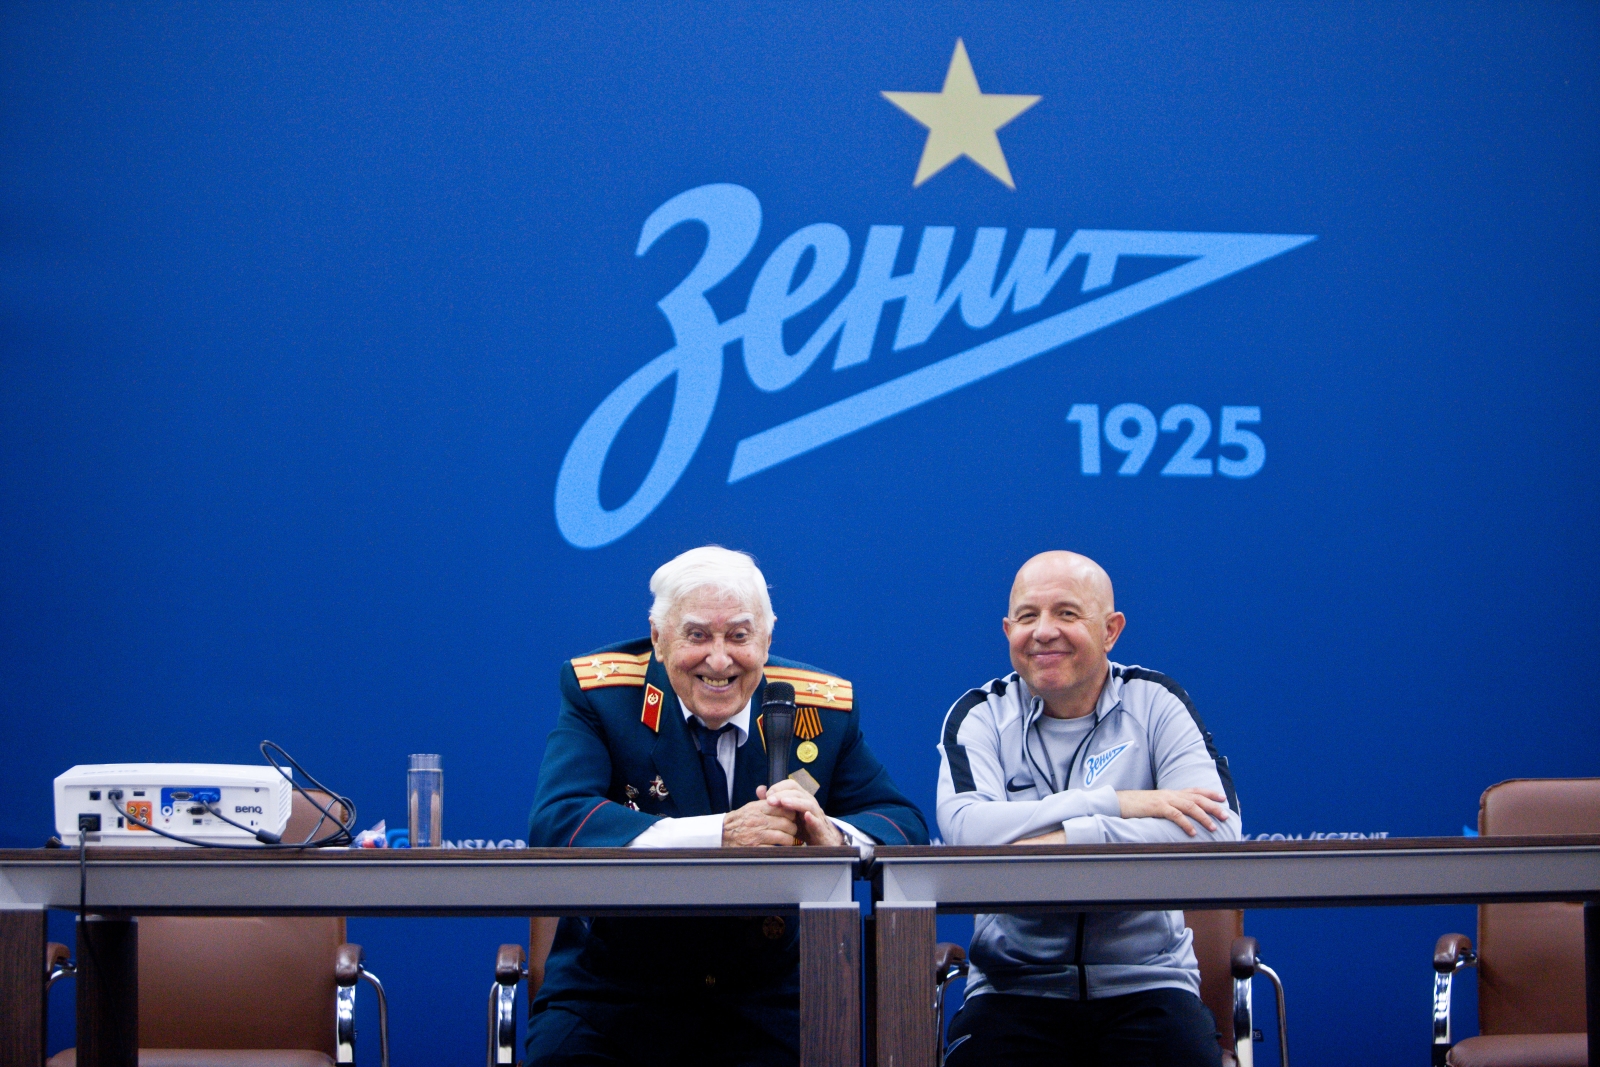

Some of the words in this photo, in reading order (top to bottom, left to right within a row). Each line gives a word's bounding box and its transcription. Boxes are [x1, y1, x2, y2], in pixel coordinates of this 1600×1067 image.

[1066, 403, 1266, 479] 1925
[235, 805, 263, 815] BenQ
[441, 838, 530, 850] INSTAGR
